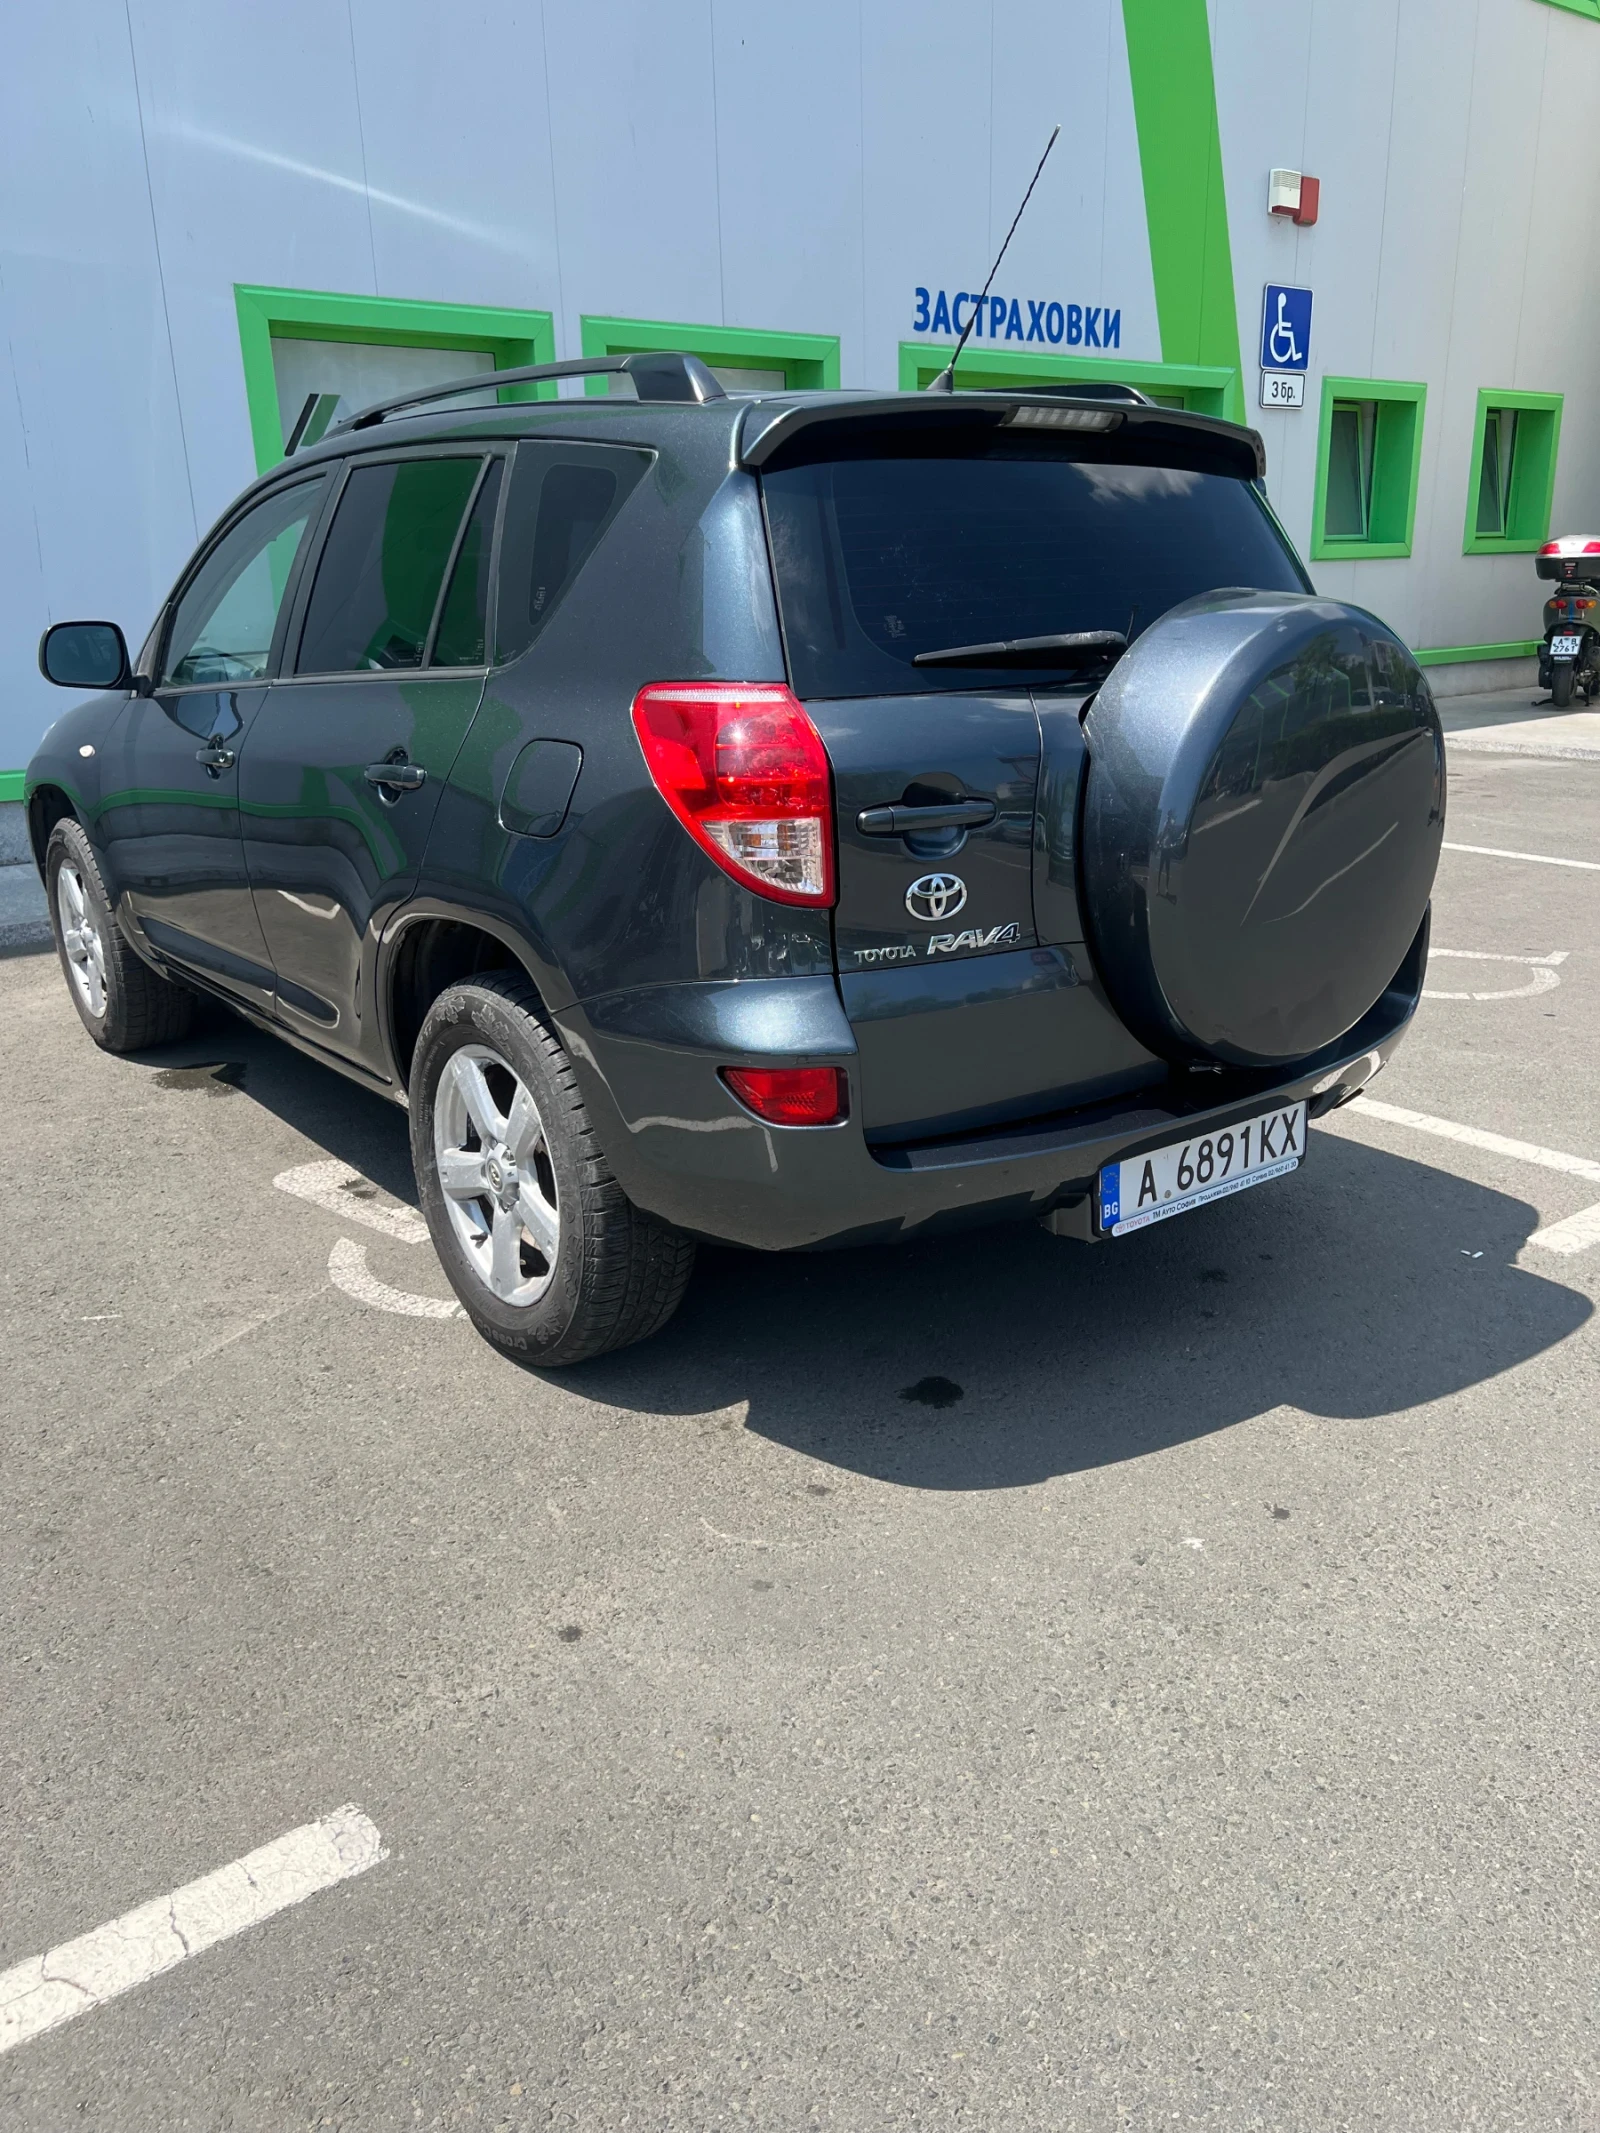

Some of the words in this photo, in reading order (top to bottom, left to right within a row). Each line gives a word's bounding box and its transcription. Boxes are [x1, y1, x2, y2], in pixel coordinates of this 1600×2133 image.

[913, 287, 1121, 349] ЗАСТРАХОВКИ
[1271, 381, 1279, 398] 3
[1281, 382, 1296, 403] бр.
[854, 945, 917, 964] TOYOTA
[926, 922, 1021, 955] RAV4
[1103, 1201, 1119, 1219] BG
[1126, 1215, 1151, 1229] TOYOTA
